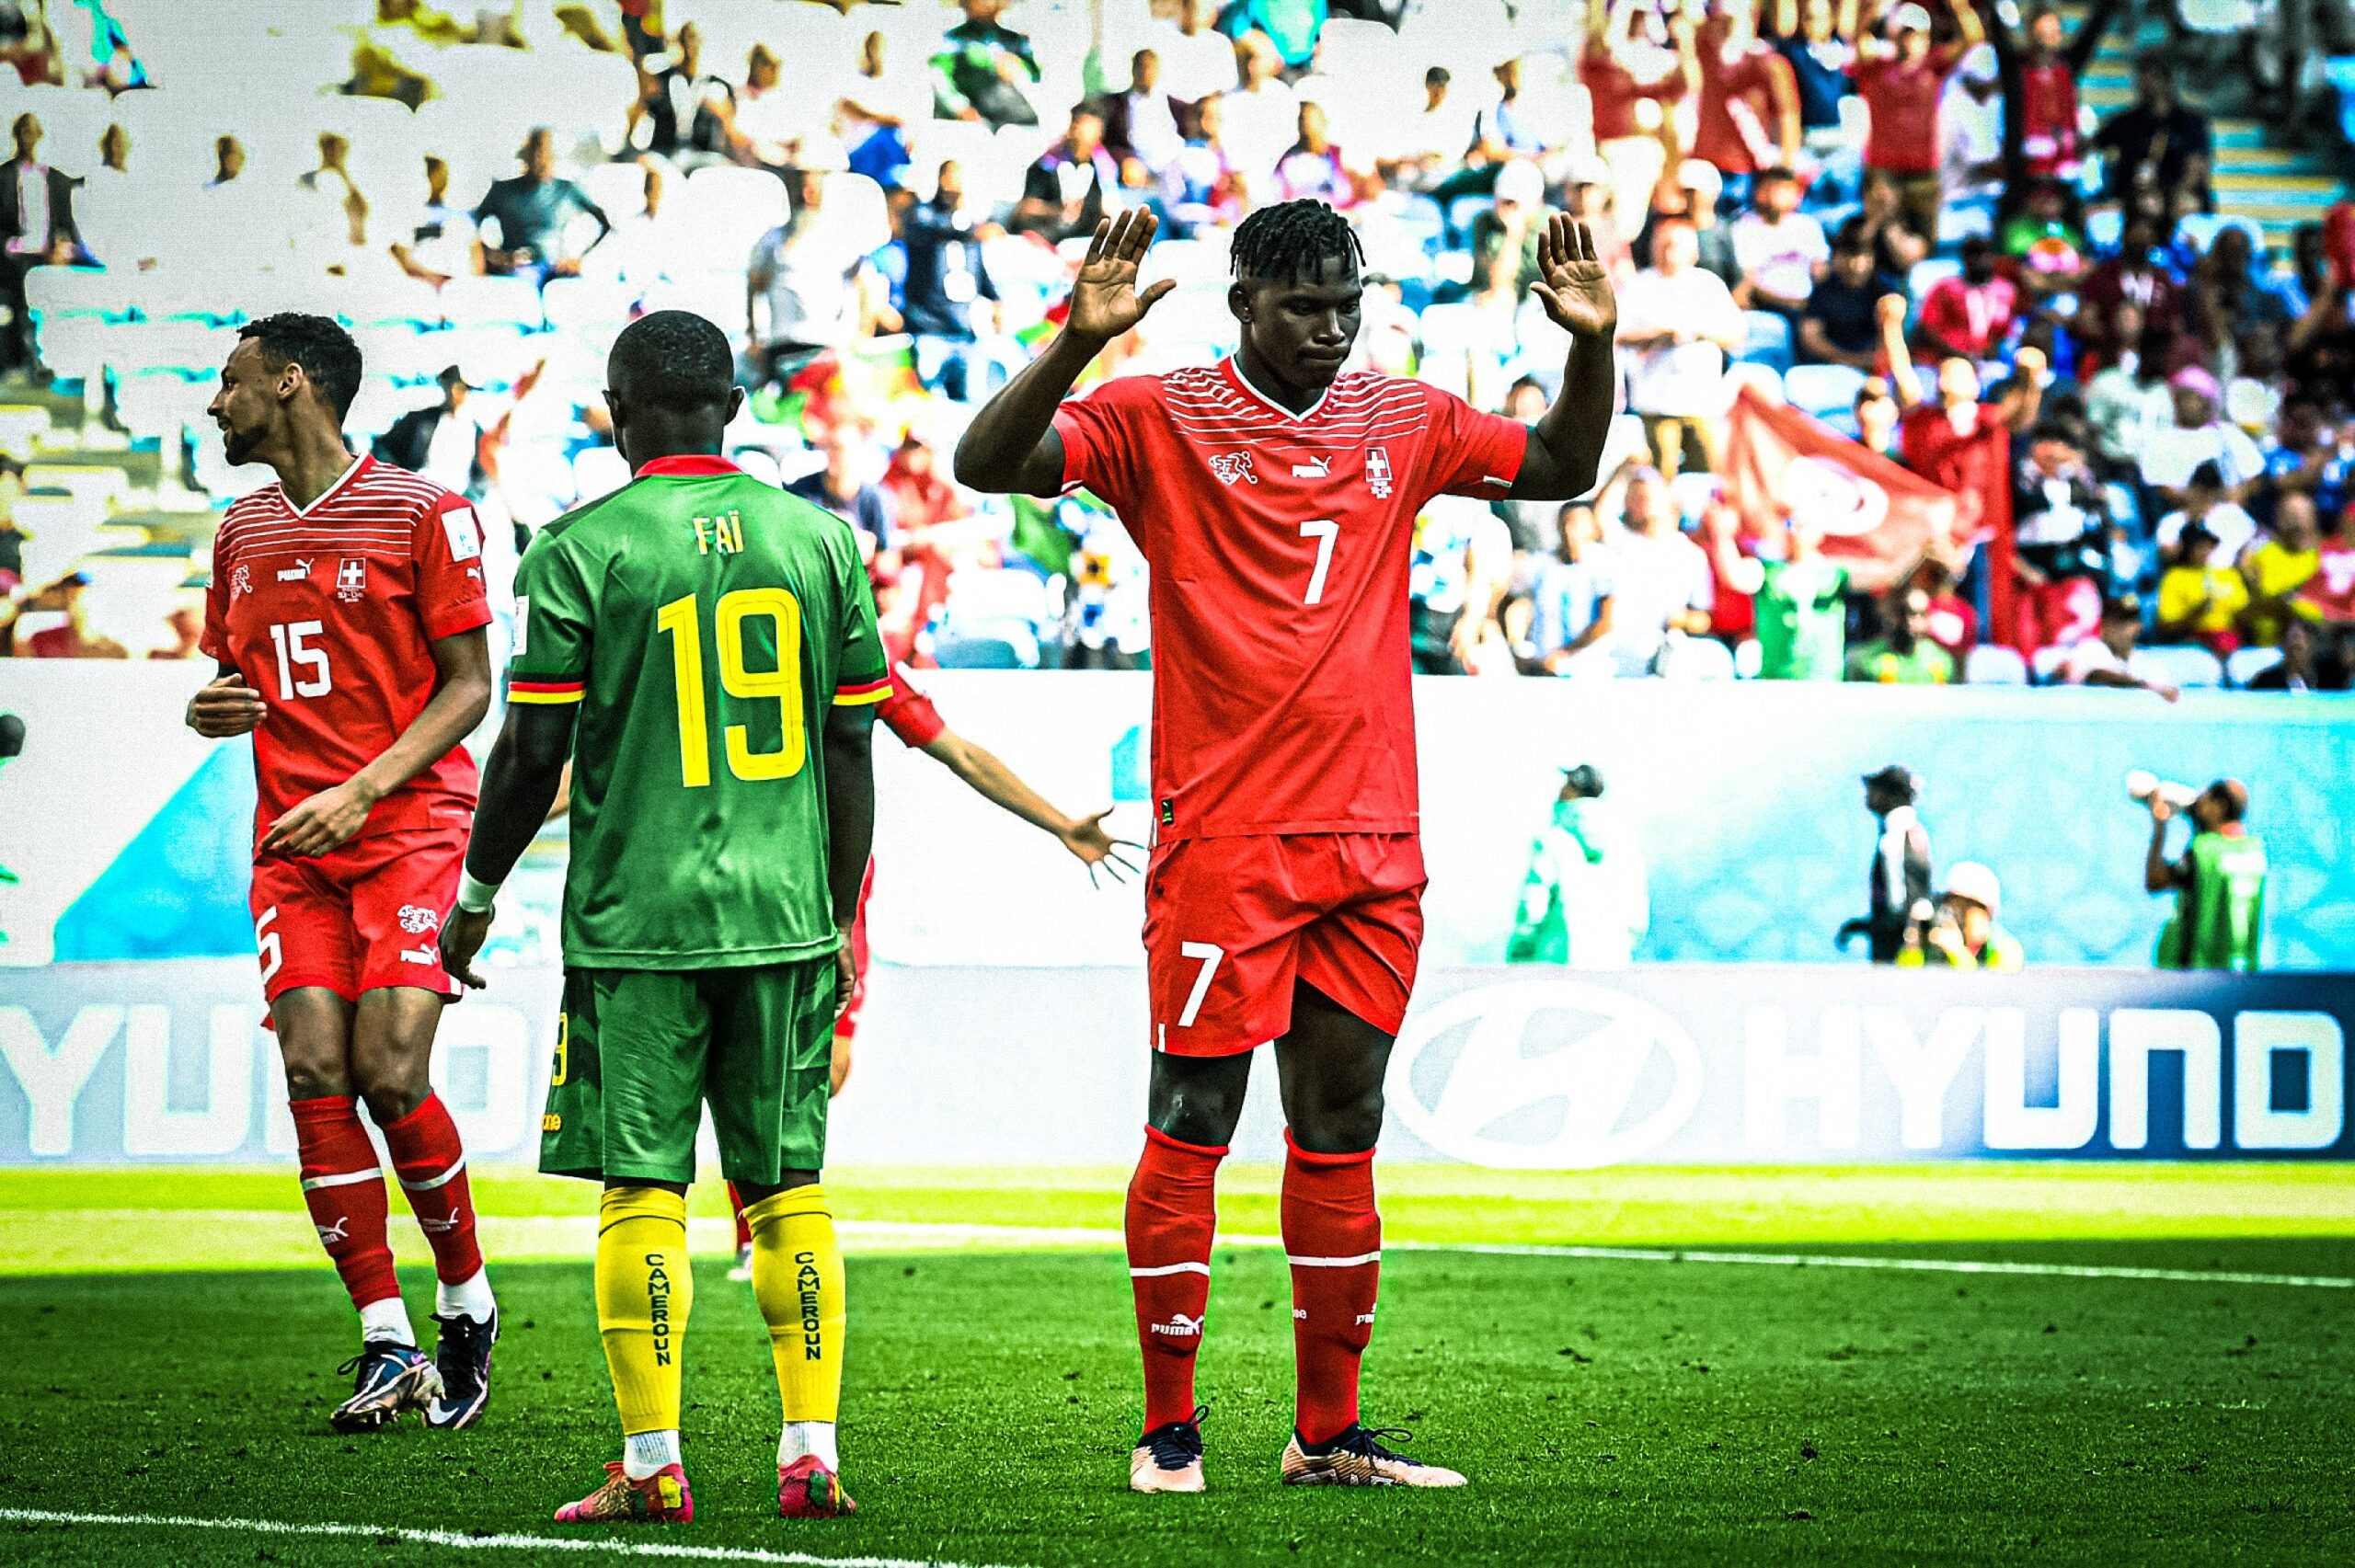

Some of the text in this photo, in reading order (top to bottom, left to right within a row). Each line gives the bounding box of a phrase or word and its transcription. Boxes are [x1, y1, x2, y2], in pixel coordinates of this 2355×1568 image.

[693, 509, 744, 555] FAÏ
[1300, 520, 1339, 604] 7
[270, 620, 332, 701] 15
[658, 588, 806, 787] 19
[1178, 941, 1224, 1027] 7
[1744, 1007, 2345, 1150] HYUND
[645, 1253, 672, 1367] CAMEROUN
[795, 1252, 821, 1361] CAMEROUN
